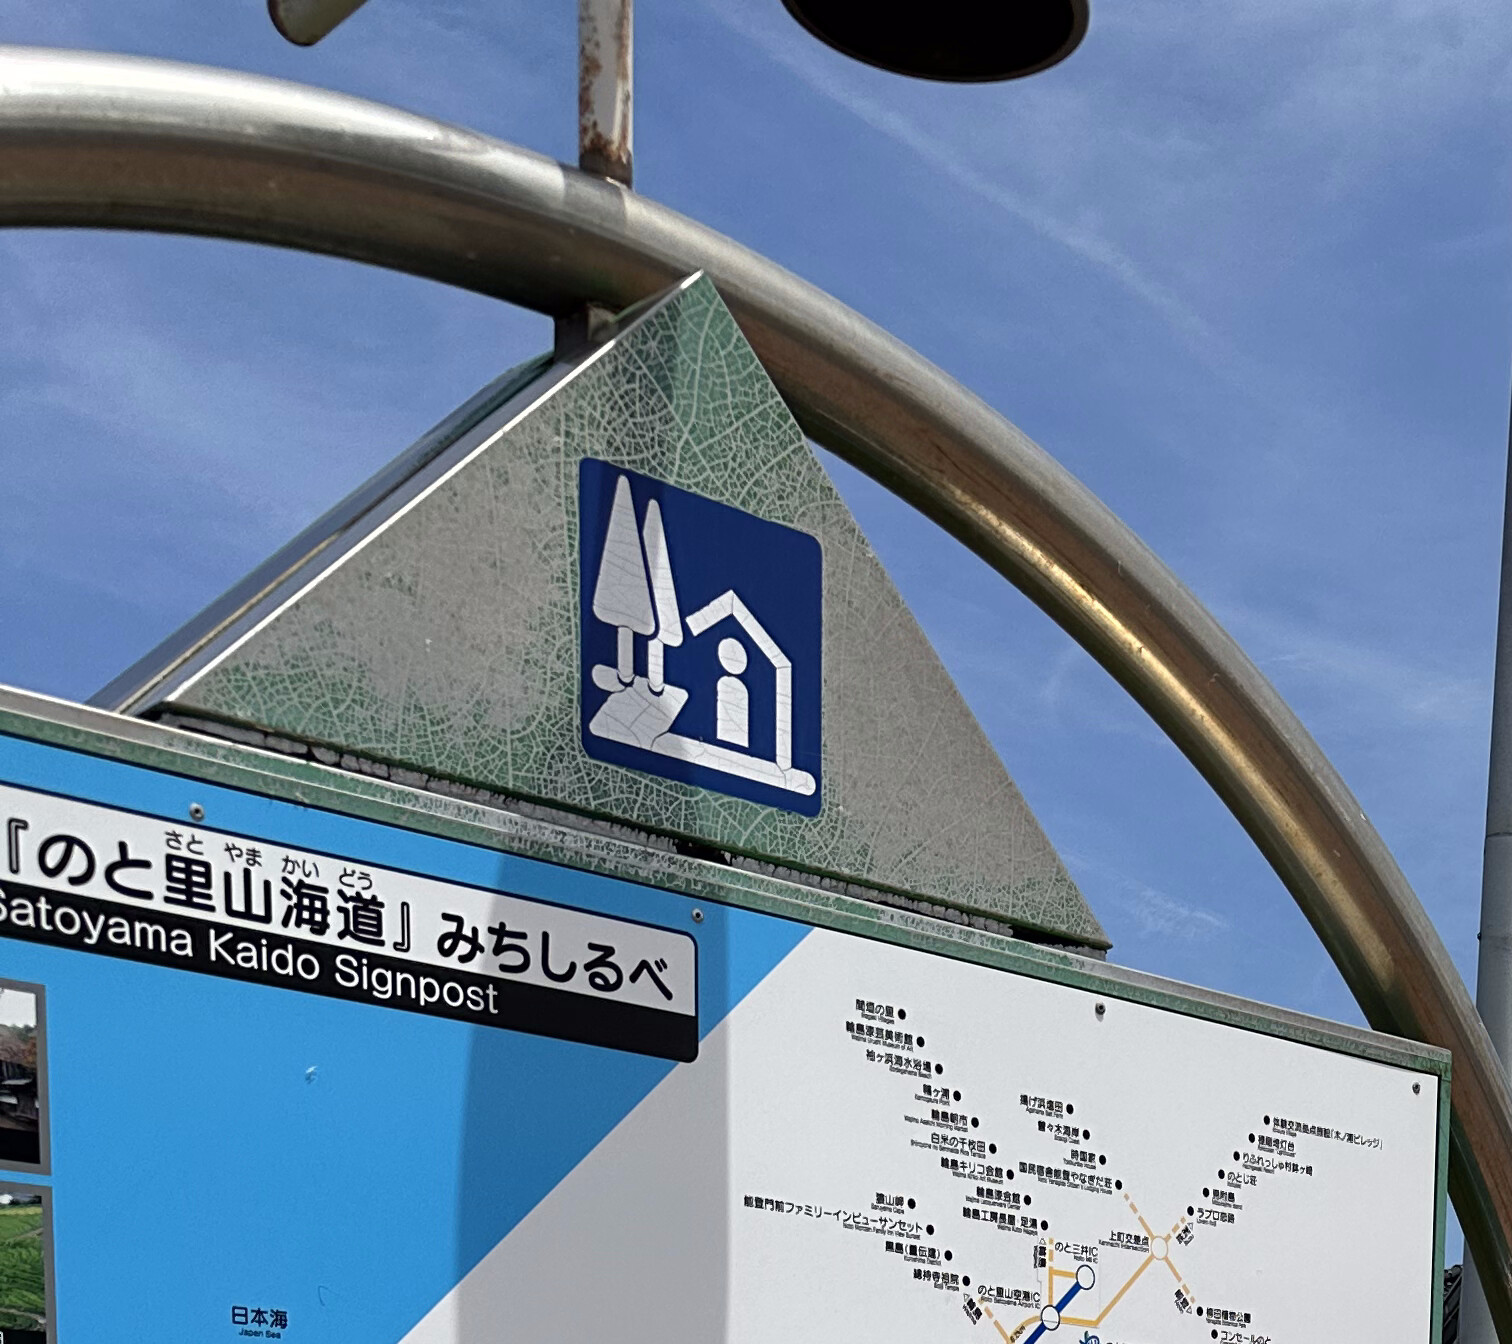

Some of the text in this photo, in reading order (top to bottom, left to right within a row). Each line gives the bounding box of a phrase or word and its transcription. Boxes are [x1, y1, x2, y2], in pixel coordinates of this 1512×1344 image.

[164, 830, 373, 891] さと やま かい どう
[208, 924, 321, 982] Kaido
[334, 956, 500, 1014] Signpost
[231, 1305, 289, 1330] 日本海
